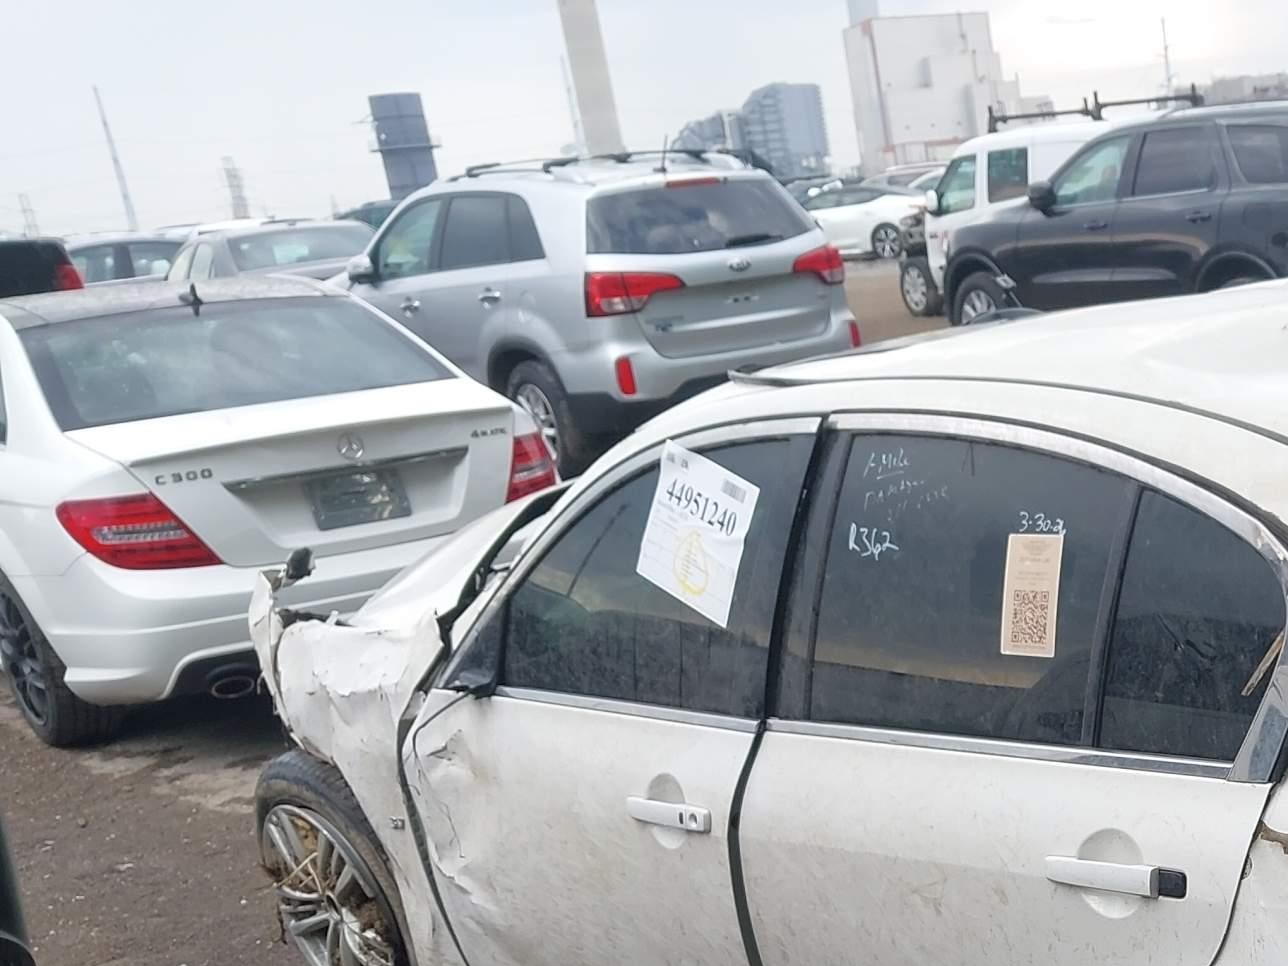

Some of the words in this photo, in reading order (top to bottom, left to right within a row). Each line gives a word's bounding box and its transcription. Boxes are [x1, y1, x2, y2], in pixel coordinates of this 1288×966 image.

[155, 474, 167, 486] C
[666, 478, 738, 537] 44951240
[848, 522, 899, 561] R362
